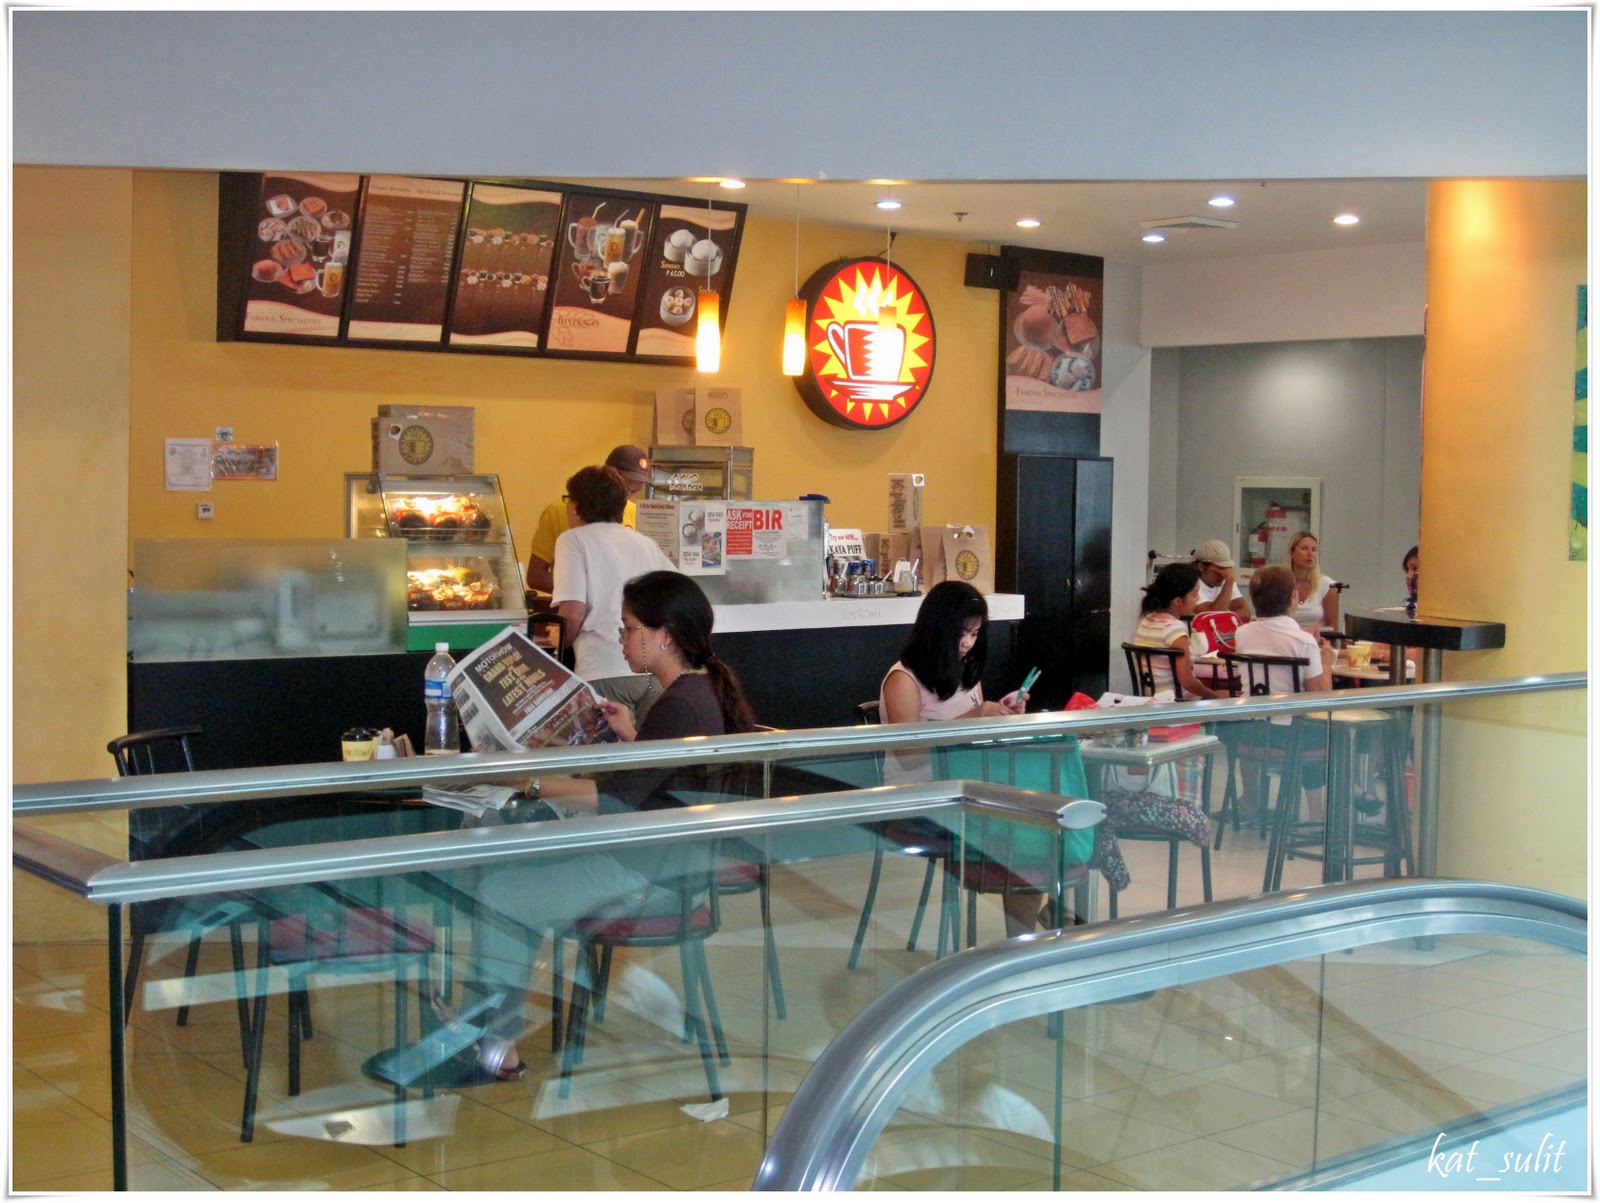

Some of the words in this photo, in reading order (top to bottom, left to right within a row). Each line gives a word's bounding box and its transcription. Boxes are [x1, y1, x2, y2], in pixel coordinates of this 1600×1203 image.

[727, 510, 742, 520] ASK
[753, 509, 783, 530] BIR
[726, 521, 752, 530] RECEIPT
[828, 545, 847, 554] KAYA
[847, 544, 862, 554] PUFF
[482, 661, 507, 683] GRAND
[498, 671, 516, 689] TEST
[502, 683, 527, 707] LATEST
